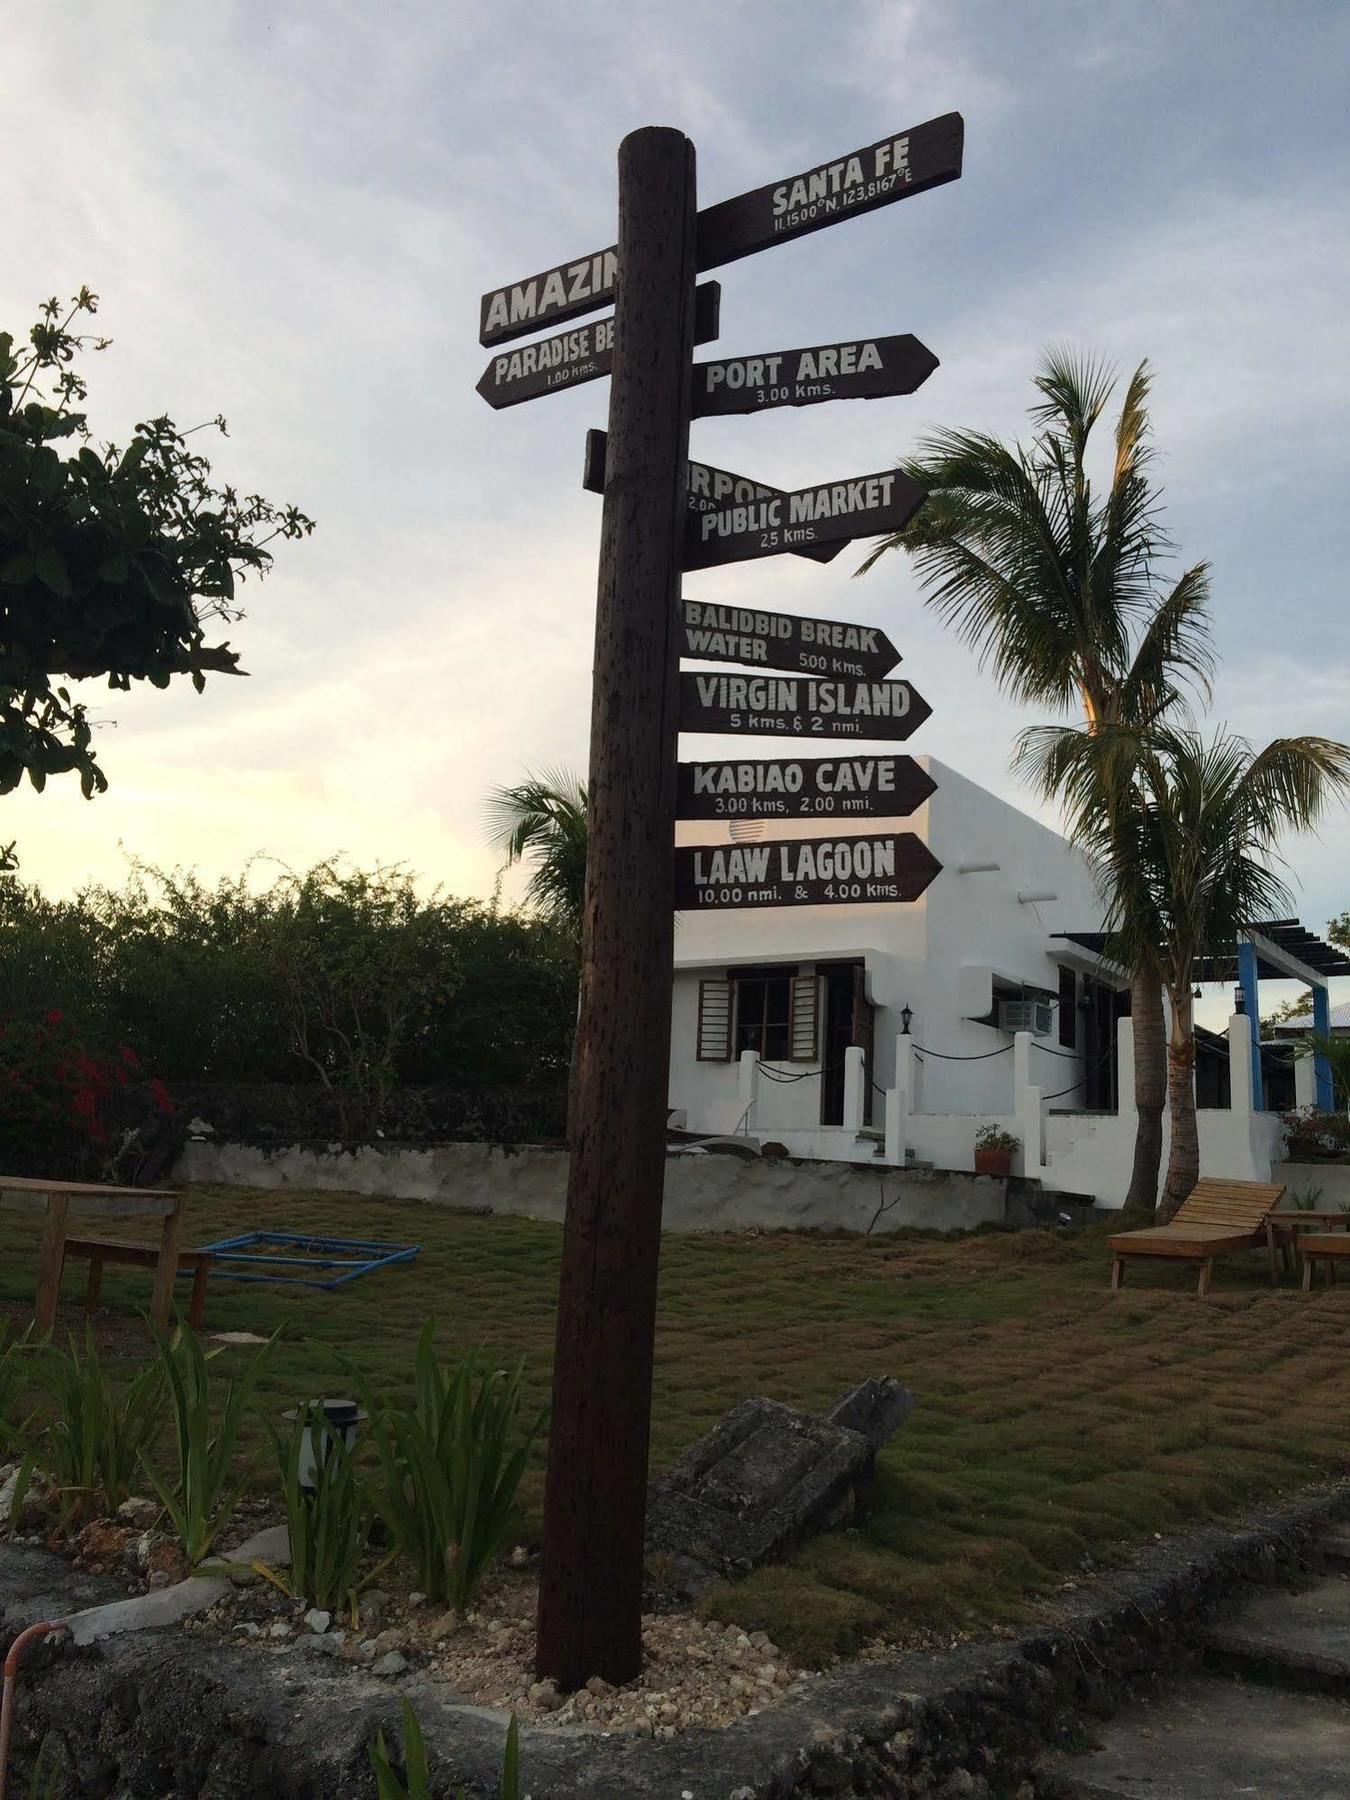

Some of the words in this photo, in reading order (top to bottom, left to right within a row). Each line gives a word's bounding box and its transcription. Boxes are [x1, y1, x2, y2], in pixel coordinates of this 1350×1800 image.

[773, 157, 863, 216] SANTA
[875, 137, 909, 177] FE
[495, 331, 589, 385] PARADISE
[706, 357, 782, 392] PORT
[797, 343, 883, 381] AREA
[547, 368, 570, 385] 1.00
[756, 387, 789, 403] 3.00
[795, 379, 836, 398] kms.
[702, 499, 781, 541] PUBLIC
[790, 475, 895, 524] MARKET
[760, 531, 778, 548] 2.5
[685, 602, 792, 638] BALIDBID
[800, 621, 878, 653] BREAK
[686, 629, 767, 661] WATER
[832, 658, 866, 677] kms.
[696, 677, 797, 711] VIRGIN
[808, 681, 911, 717] ISLAND
[730, 714, 741, 727] 5
[748, 714, 789, 729] kms.
[793, 716, 803, 731] &
[811, 717, 824, 730] 2
[832, 719, 863, 733] nmi.
[694, 764, 803, 794] KABIAO
[815, 761, 896, 792] CAVE
[715, 798, 747, 813] 3.00
[800, 797, 834, 812] 2.00
[842, 796, 874, 811] nmi.
[694, 847, 770, 885] LAAW
[780, 840, 896, 881] LAGOON
[699, 888, 742, 903] 10.00
[747, 886, 782, 900] nmi.
[794, 885, 808, 898] &
[824, 884, 861, 899] 4.00
